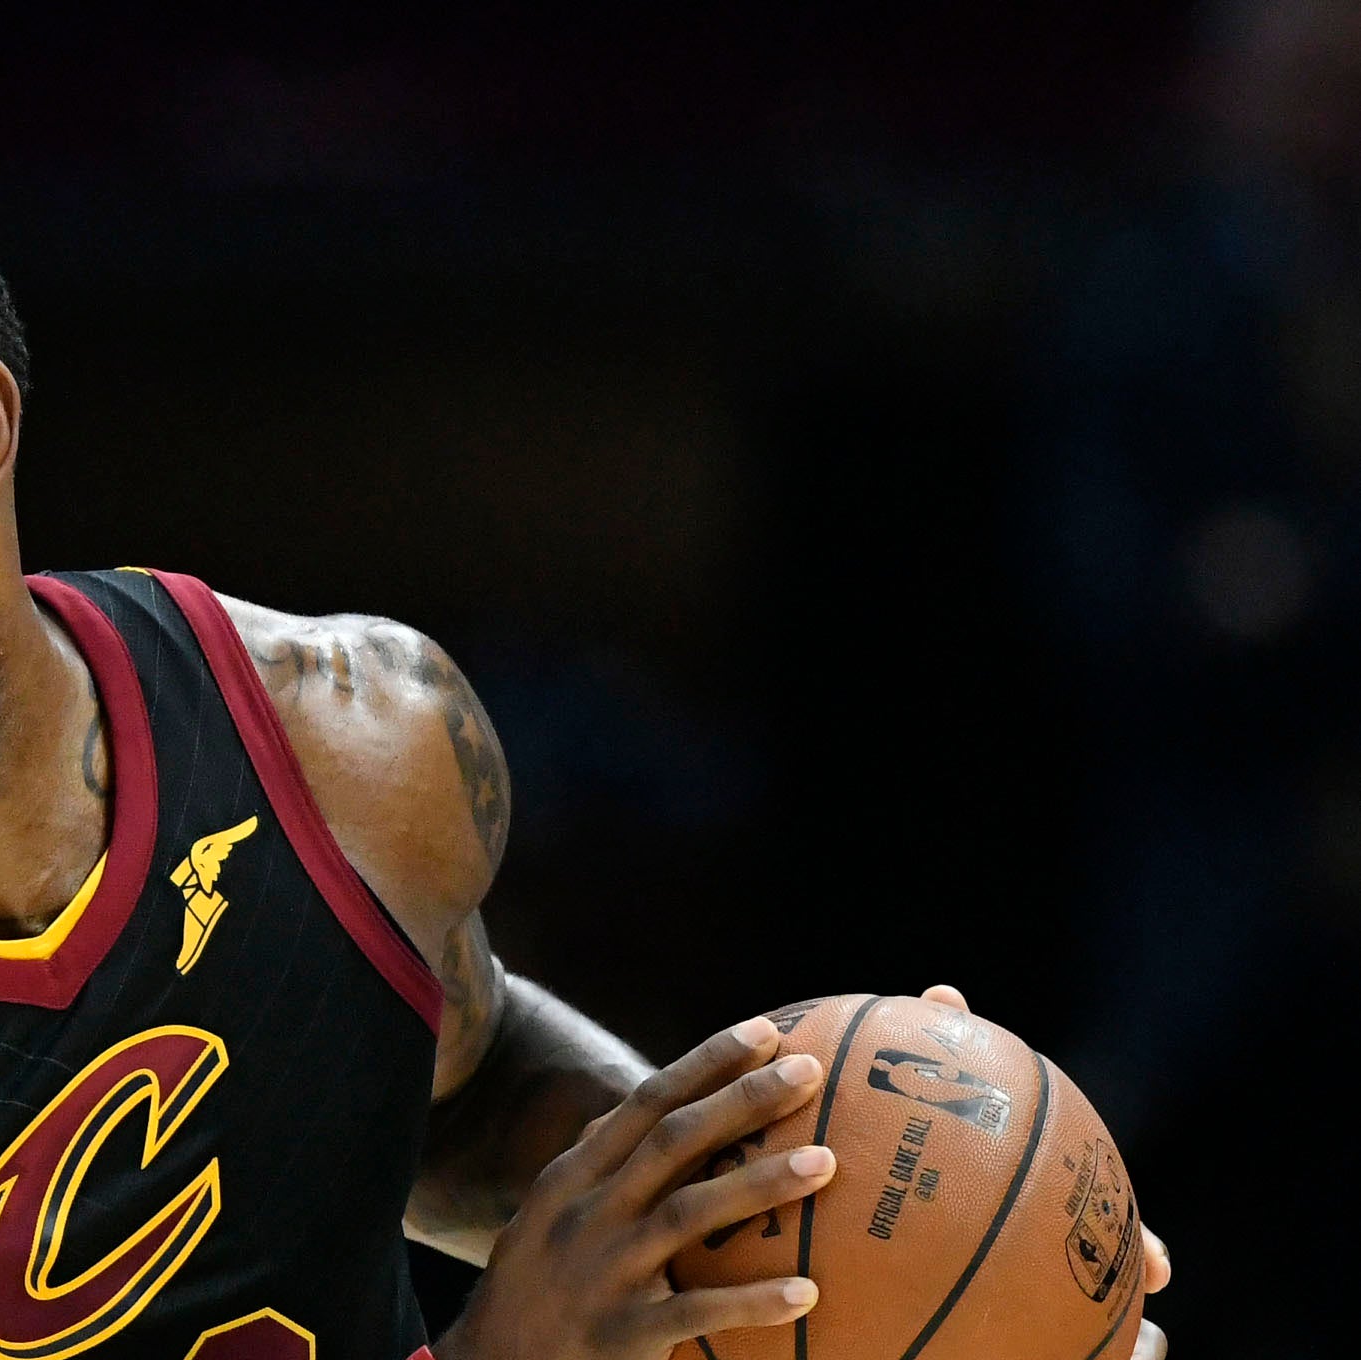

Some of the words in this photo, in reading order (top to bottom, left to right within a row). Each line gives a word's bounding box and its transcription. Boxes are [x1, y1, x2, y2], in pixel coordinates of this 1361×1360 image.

[902, 1116, 933, 1147] BALL
[888, 1144, 923, 1183] GAME
[914, 1167, 941, 1202] @NBA
[867, 1184, 908, 1241] OFFICIAL
